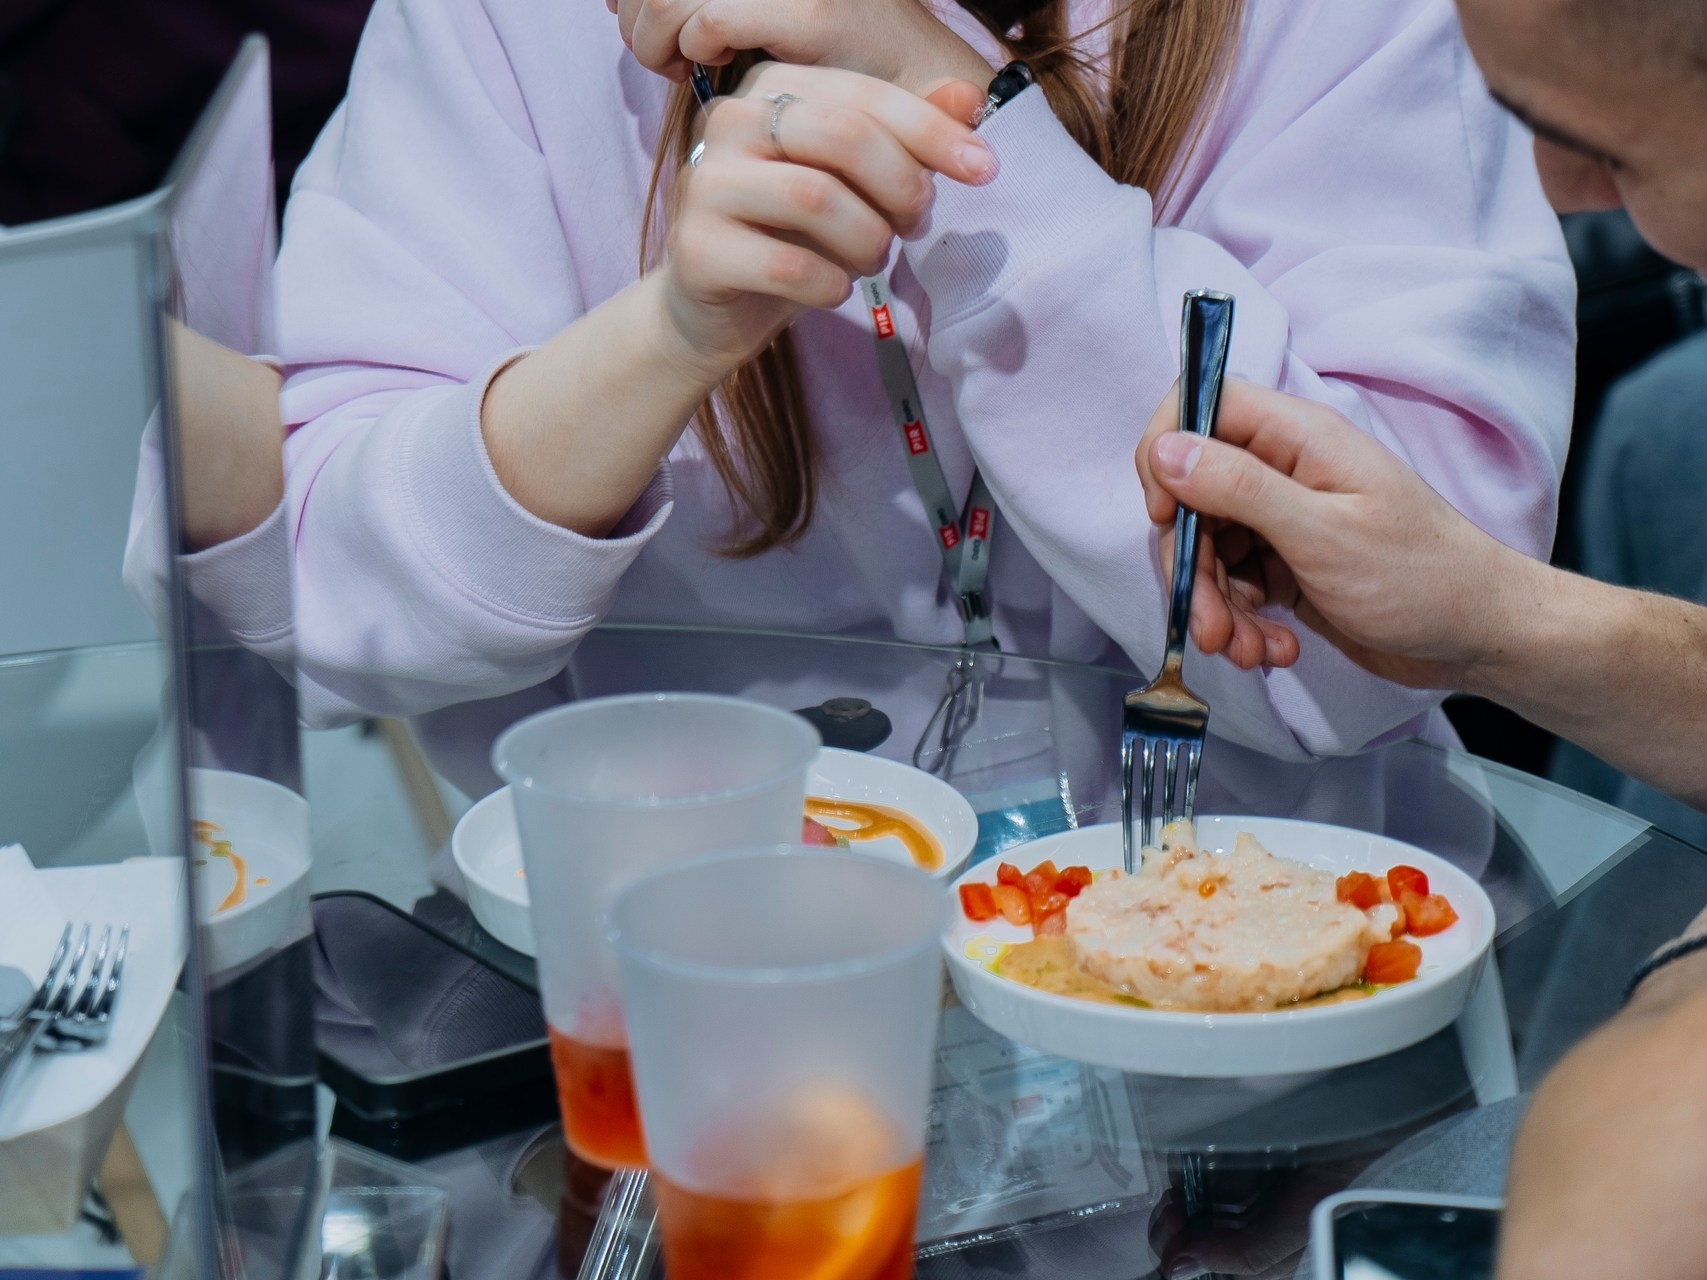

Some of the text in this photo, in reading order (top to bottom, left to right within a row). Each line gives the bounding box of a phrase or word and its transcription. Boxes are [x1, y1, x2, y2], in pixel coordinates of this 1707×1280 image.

[876, 312, 890, 334] PIR
[910, 428, 923, 451] PIR
[973, 512, 985, 532] PIR
